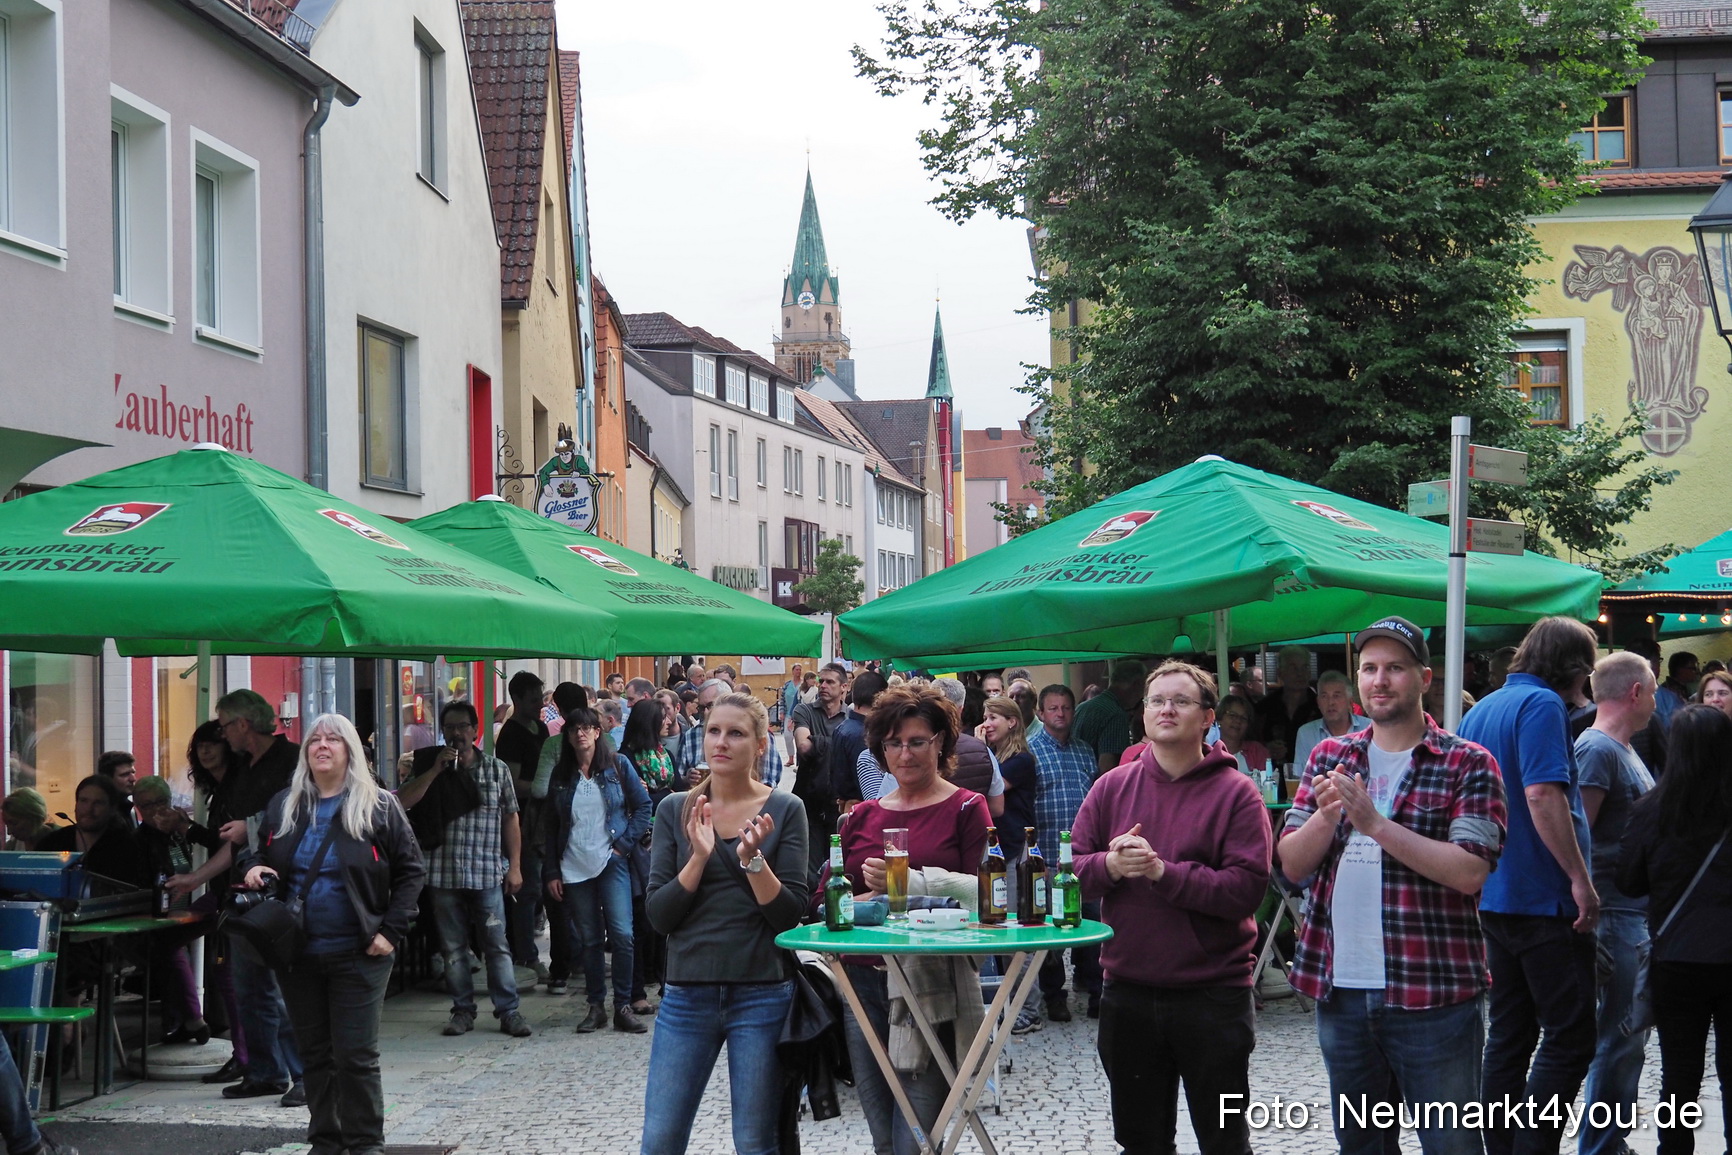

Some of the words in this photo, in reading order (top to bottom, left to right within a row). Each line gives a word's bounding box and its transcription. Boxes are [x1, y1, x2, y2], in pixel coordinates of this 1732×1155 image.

[544, 497, 589, 518] Glossner
[567, 510, 589, 520] Bier
[0, 556, 174, 573] msbräu
[1014, 551, 1149, 575] Neumarkter
[714, 566, 759, 590] HACKNER
[968, 565, 1154, 596] Lammsbräu
